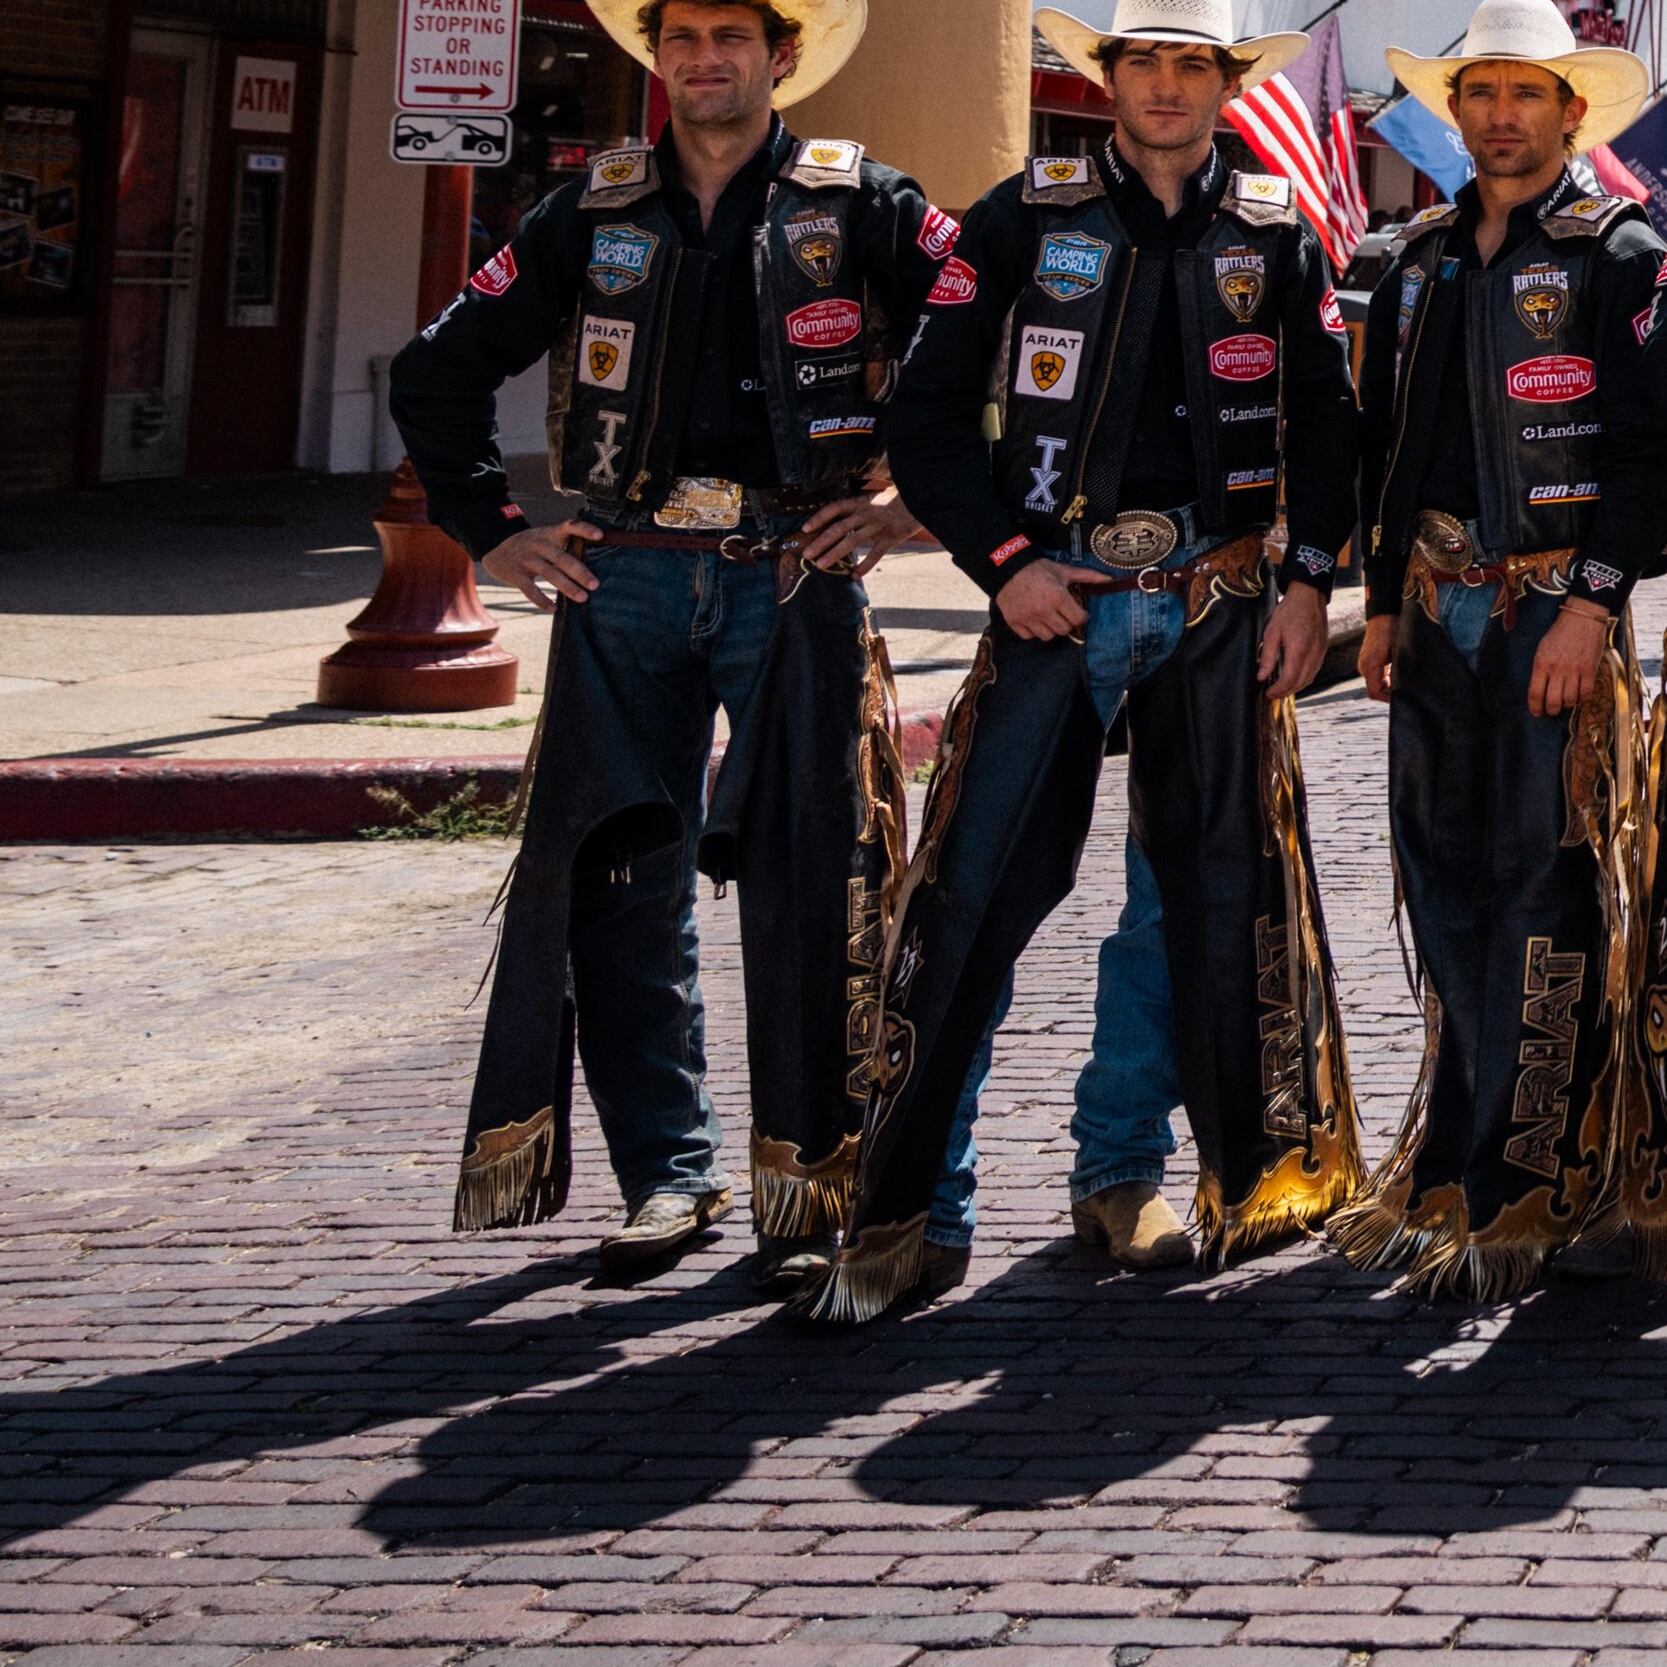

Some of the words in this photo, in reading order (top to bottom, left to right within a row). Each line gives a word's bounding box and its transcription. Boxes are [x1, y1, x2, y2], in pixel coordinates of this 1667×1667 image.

[414, 16, 505, 34] STOPPING
[447, 38, 470, 54] OR
[410, 58, 504, 77] STANDING
[237, 76, 291, 114] ATM
[1547, 172, 1571, 211] ARIAT
[594, 239, 645, 256] CAMPING
[1046, 245, 1099, 265] CAMPING
[594, 250, 644, 267] WORLD
[1046, 256, 1096, 274] WORLD
[1214, 256, 1266, 277] RATTLERS
[1513, 270, 1568, 292] RATTLERS
[584, 323, 632, 340] ARIAT
[791, 311, 859, 338] Community
[1025, 333, 1081, 350] ARIAT
[1213, 348, 1273, 368] Community
[819, 362, 860, 378] Land.com
[1513, 368, 1592, 390] Community
[1230, 405, 1276, 420] Land.com
[809, 415, 874, 434] can-am
[1227, 468, 1275, 486] can-am
[1254, 913, 1307, 1138] ARIAT
[1504, 936, 1586, 1180] ARIAT
